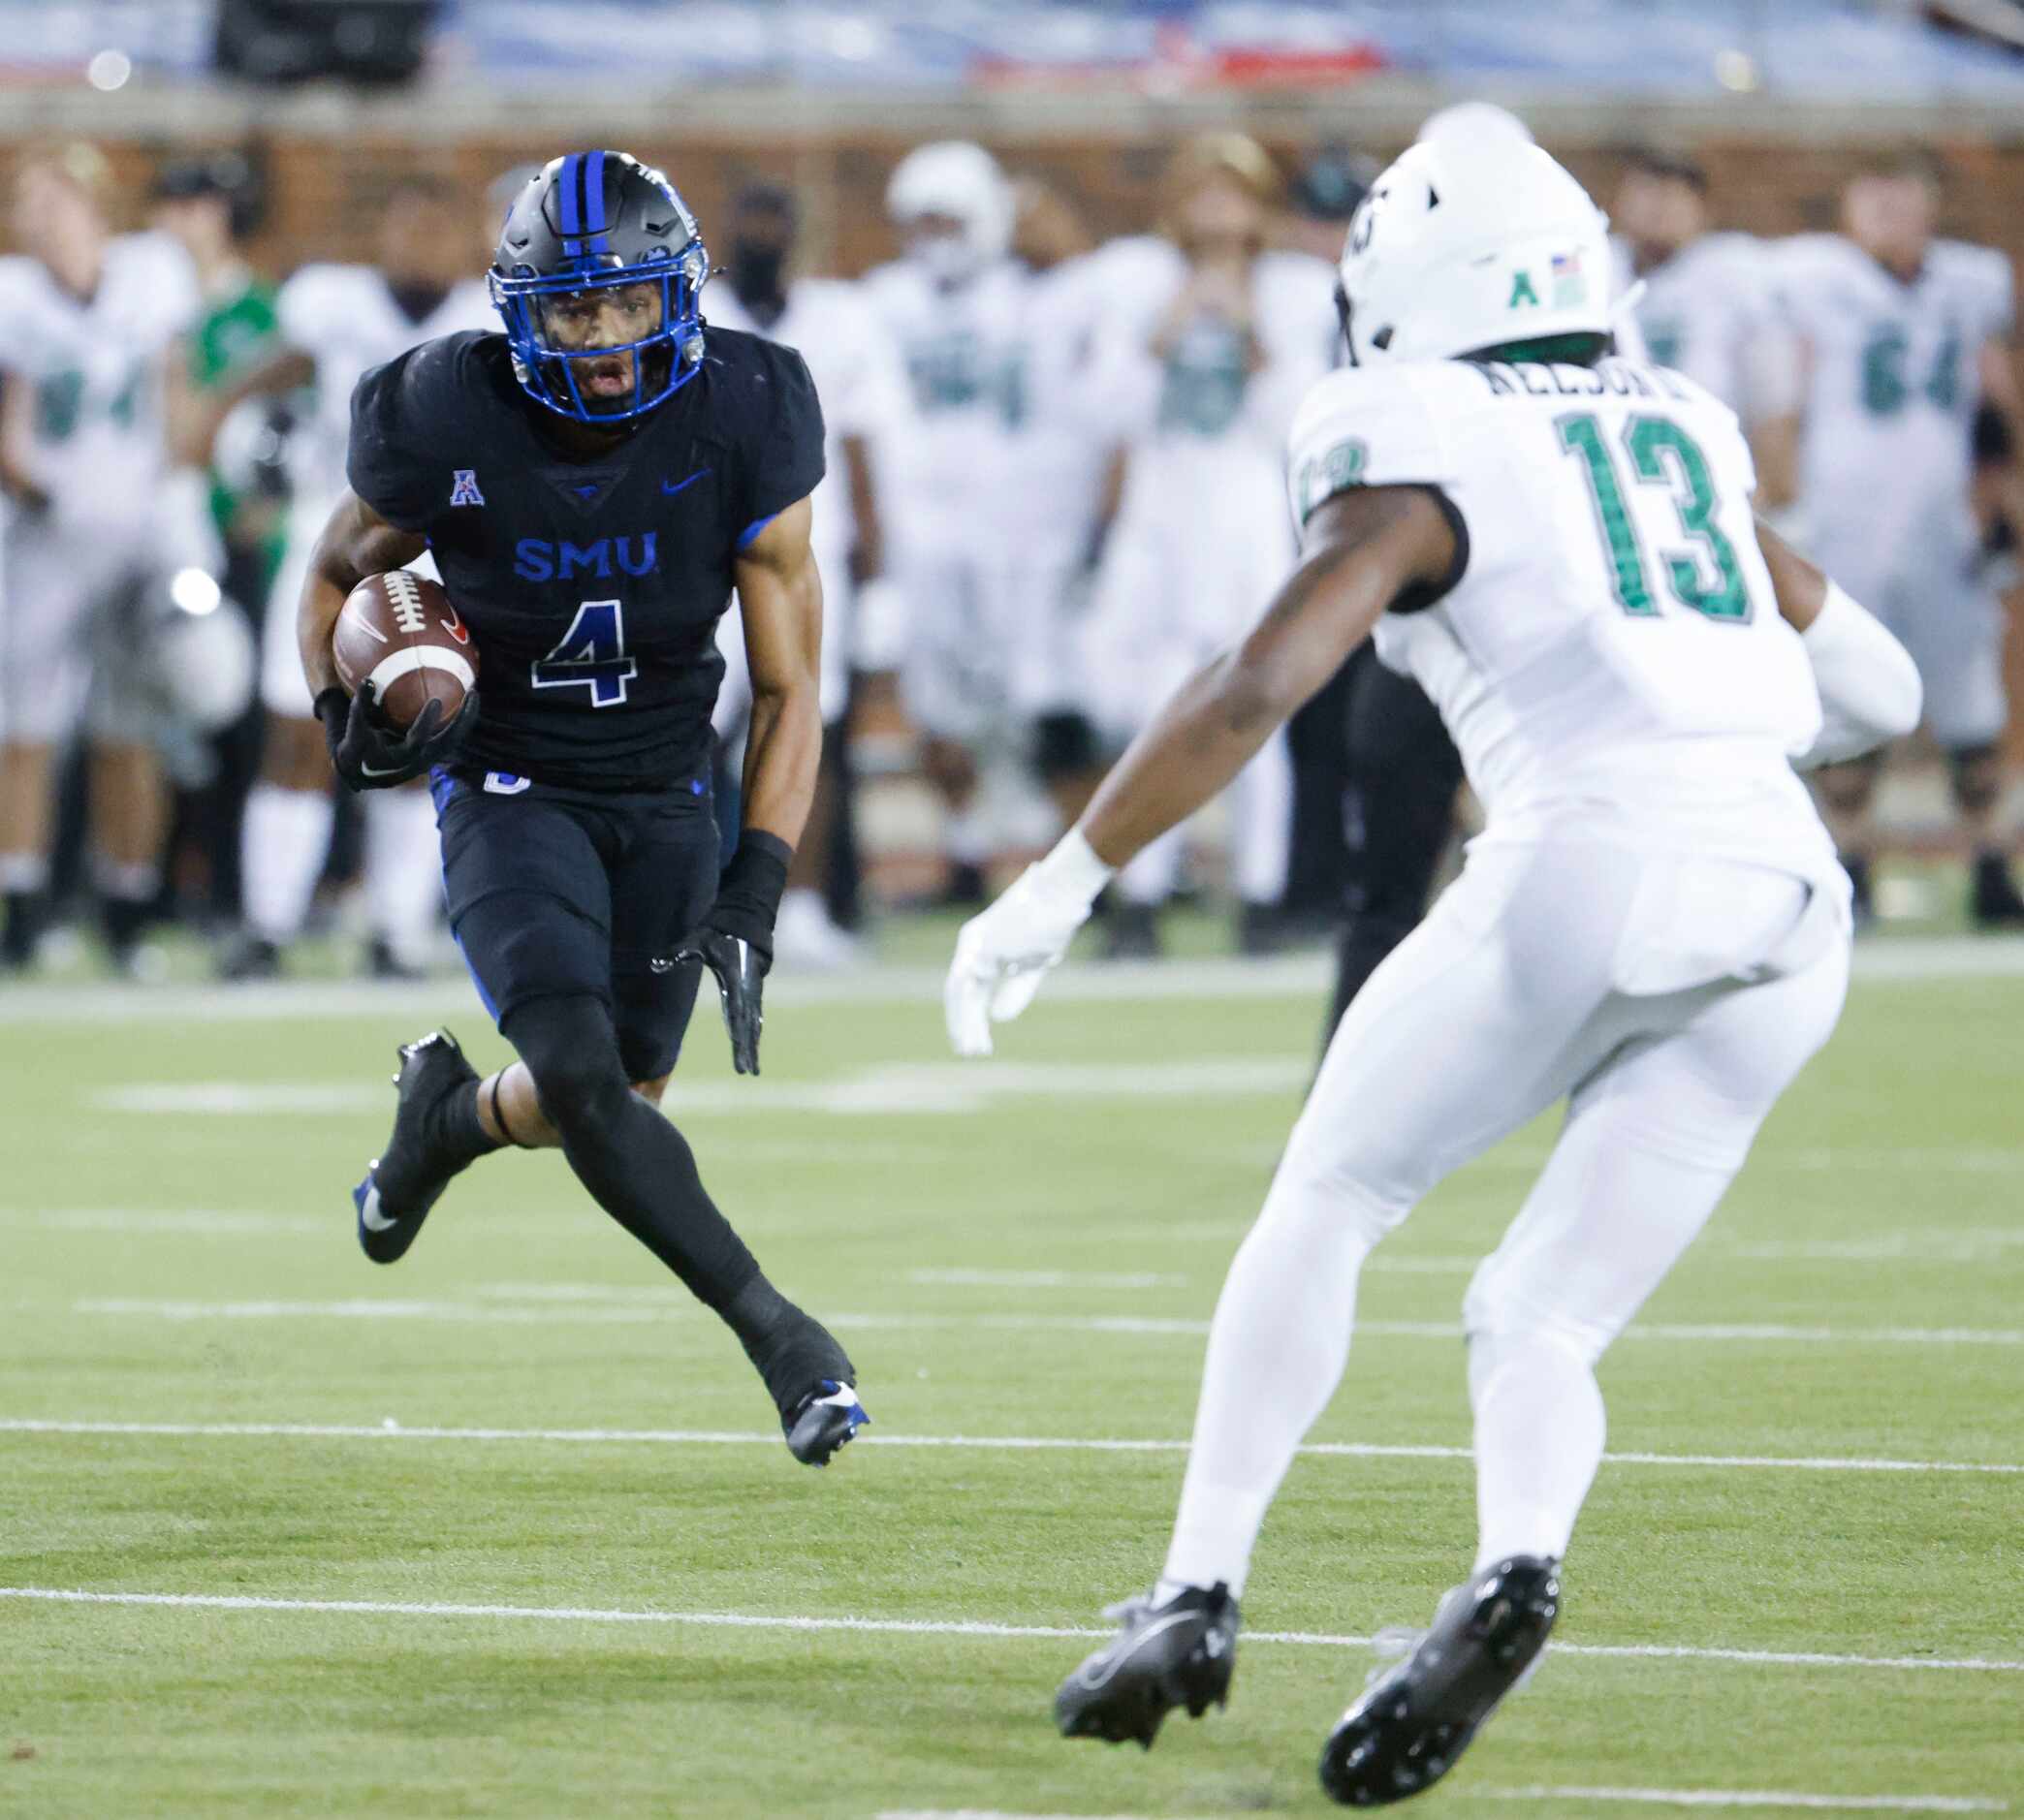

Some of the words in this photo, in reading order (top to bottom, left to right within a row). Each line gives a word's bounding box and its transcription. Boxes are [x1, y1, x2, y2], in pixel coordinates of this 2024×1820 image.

[450, 470, 485, 506] A
[1553, 410, 1754, 625] 13
[514, 531, 657, 581] SMU
[532, 599, 637, 708] 4
